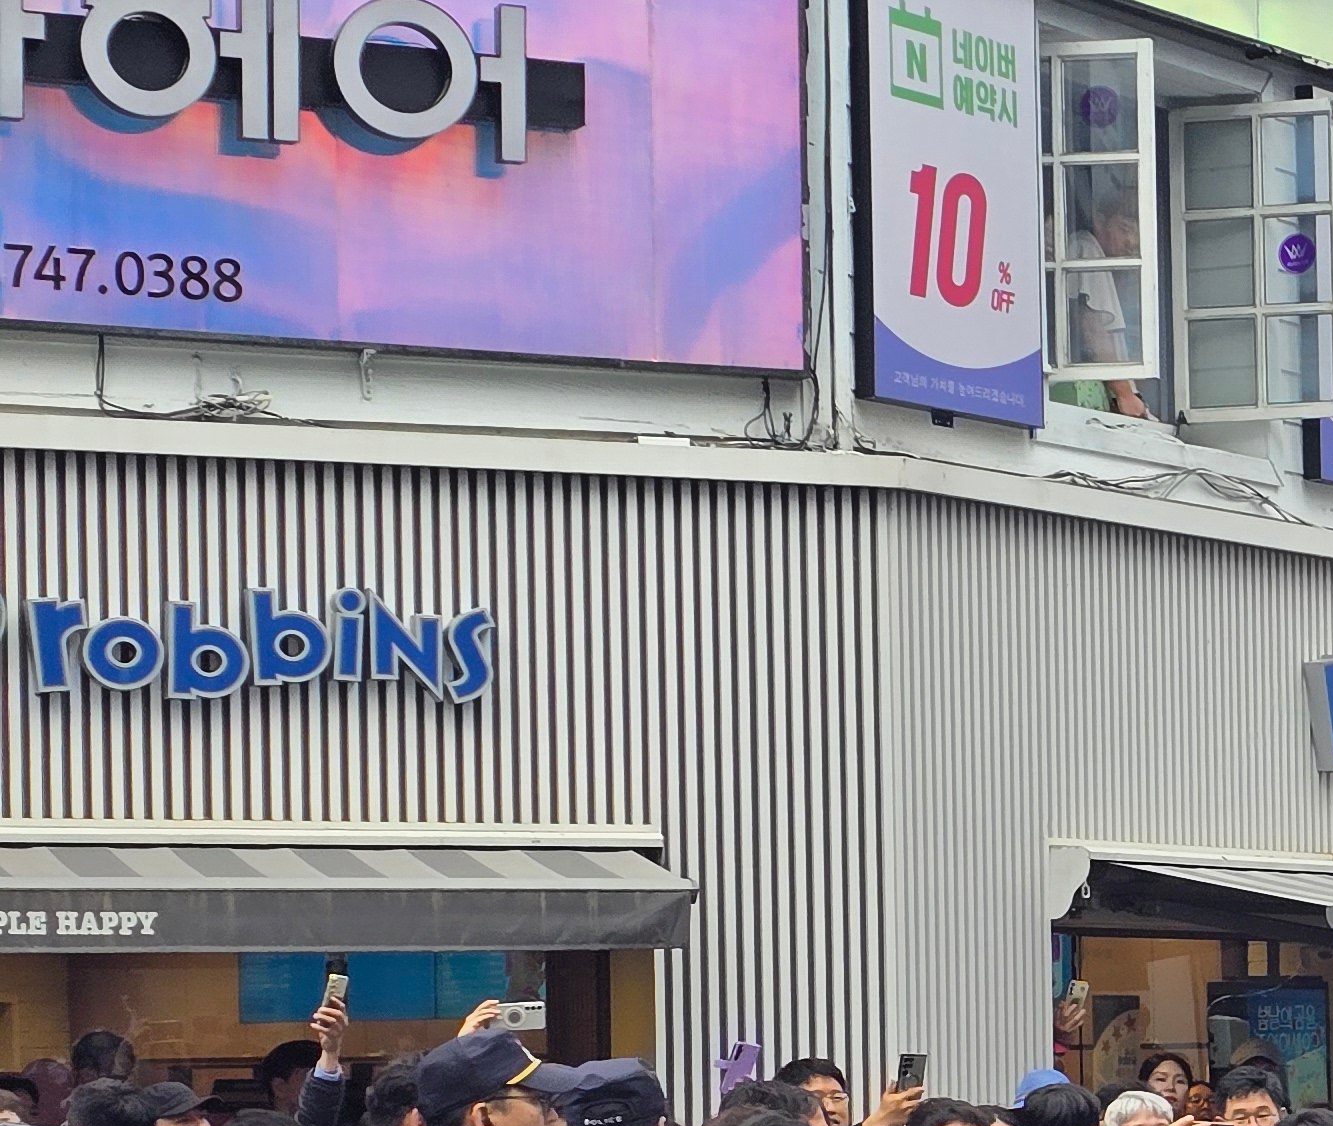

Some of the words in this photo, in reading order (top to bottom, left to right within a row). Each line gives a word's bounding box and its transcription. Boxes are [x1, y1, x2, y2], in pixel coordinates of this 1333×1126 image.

[906, 39, 928, 83] N
[952, 28, 1017, 83] 네이버
[953, 74, 1018, 128] 예약시
[909, 163, 988, 308] 10
[998, 261, 1012, 285] %
[991, 288, 1016, 313] OFF
[27, 586, 497, 705] robbins
[56, 911, 159, 936] HAPPY
